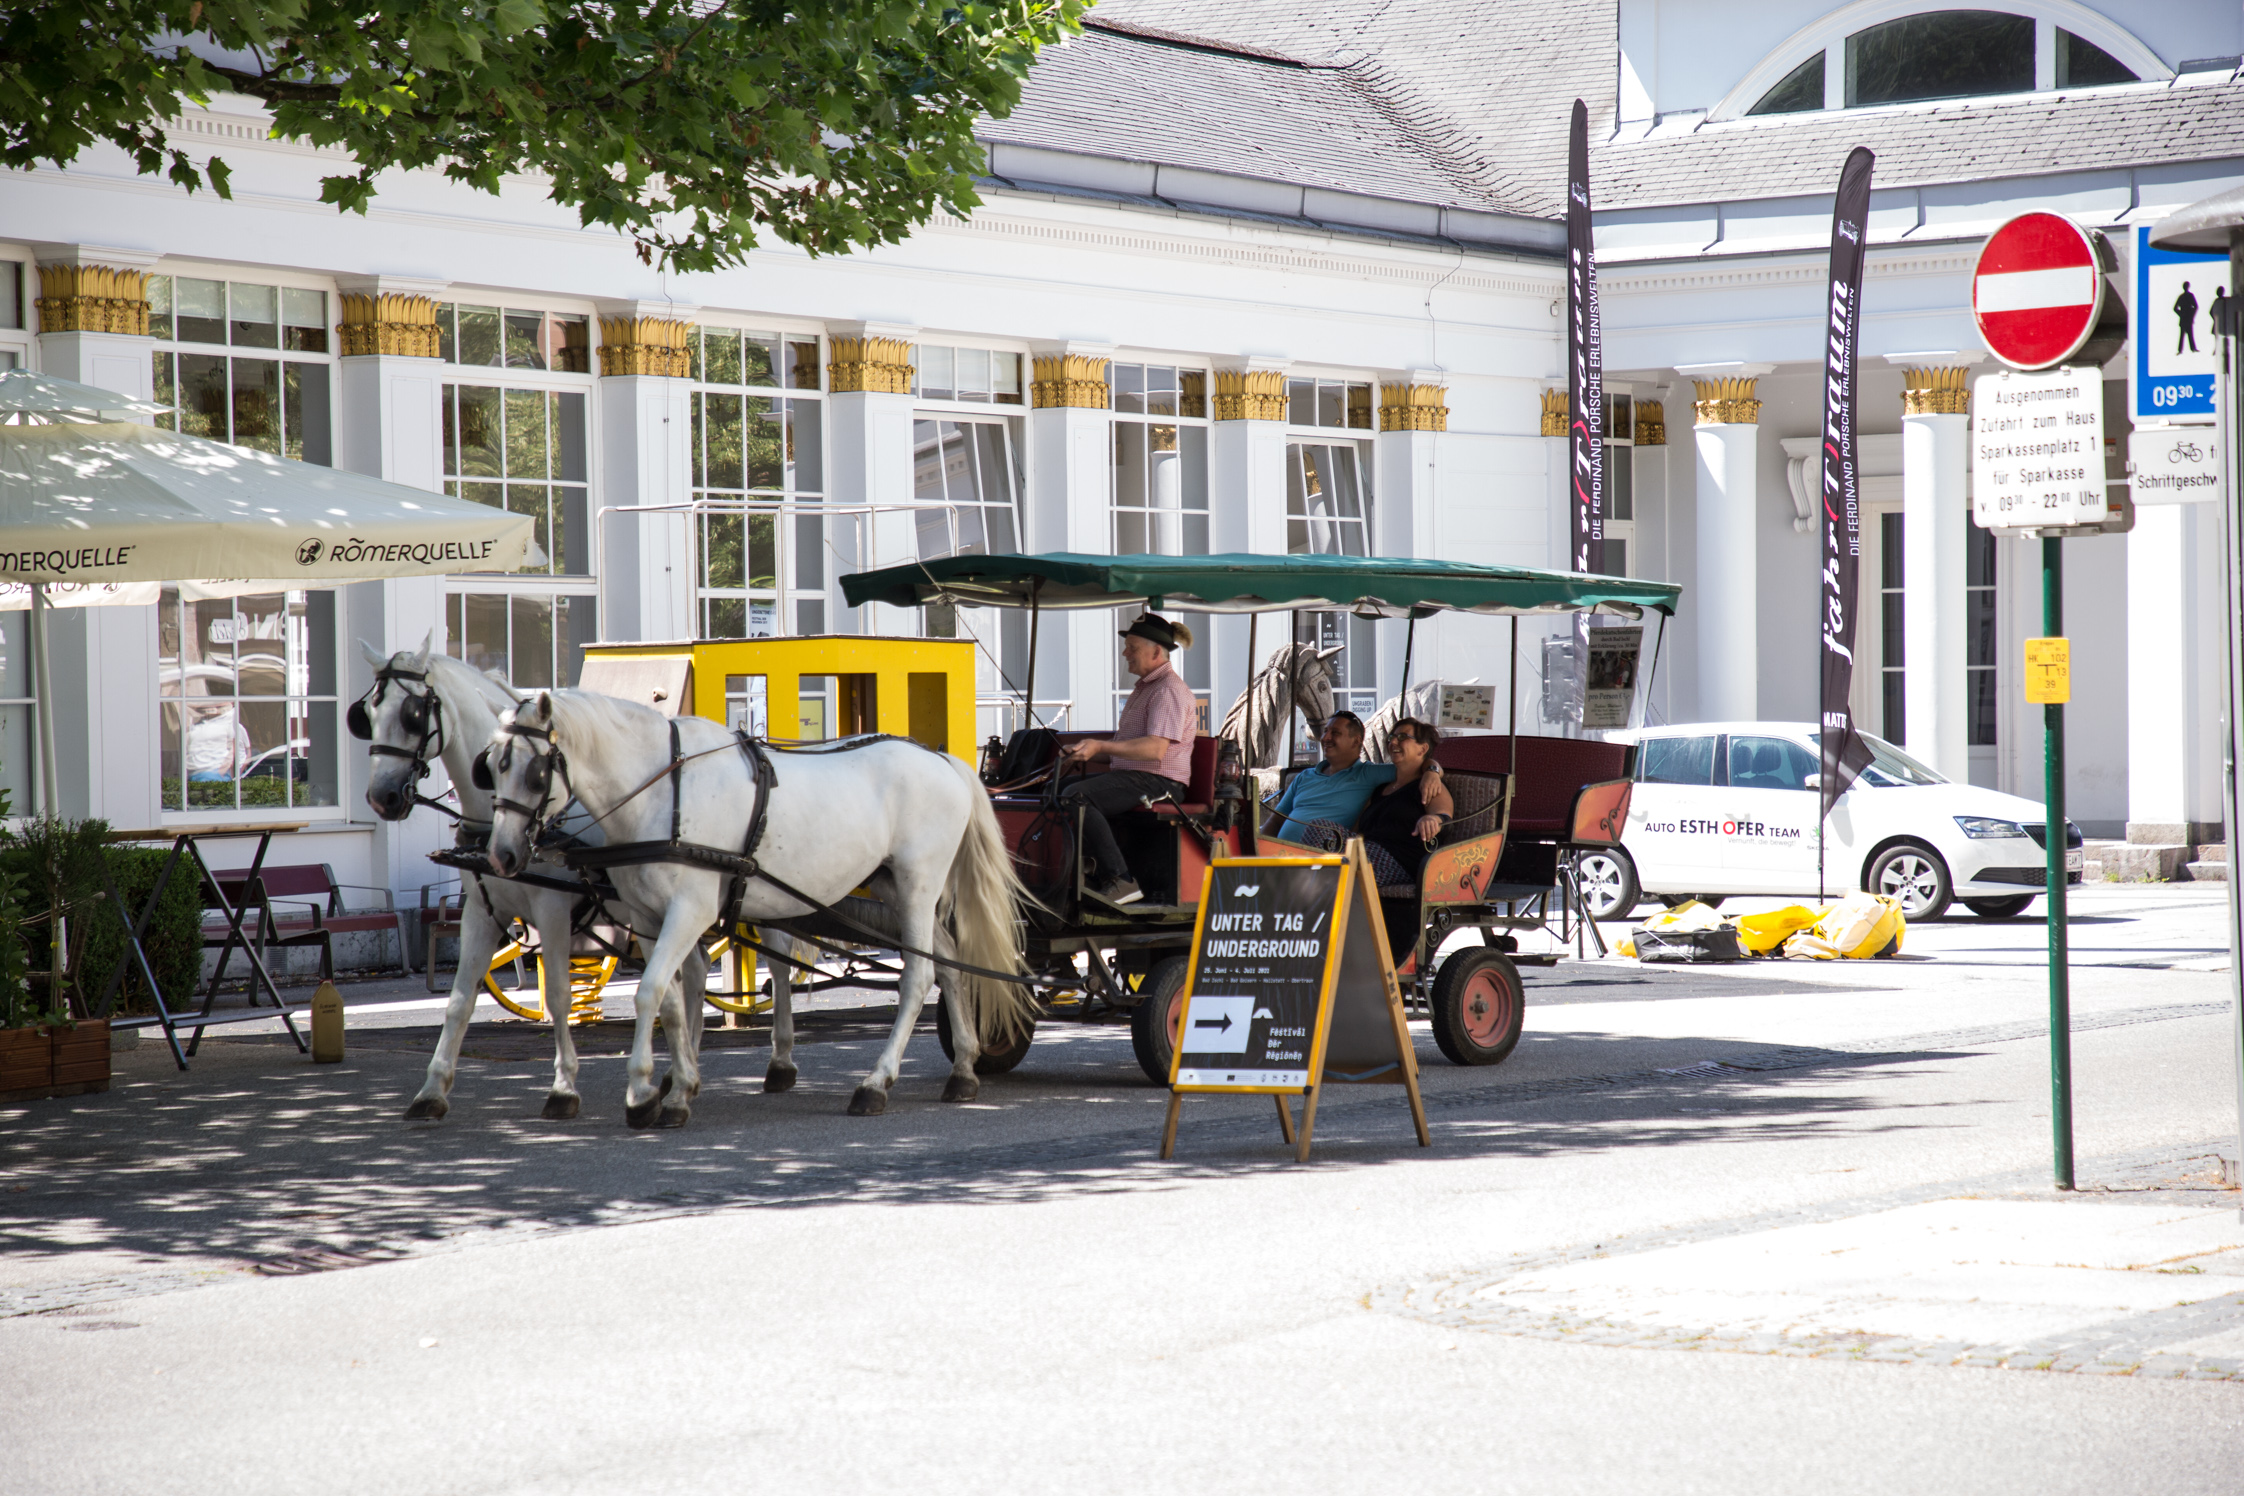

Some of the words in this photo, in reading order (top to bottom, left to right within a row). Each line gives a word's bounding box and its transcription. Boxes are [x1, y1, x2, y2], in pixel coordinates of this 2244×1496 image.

[1841, 288, 1854, 397] ERLEBNISWELTEN
[1590, 372, 1600, 432] PORSCHE
[1996, 386, 2080, 406] Ausgenommen
[1841, 400, 1850, 456] PORSCHE
[1981, 415, 2023, 433] Zufahrt
[2033, 416, 2058, 429] zum
[2066, 410, 2096, 426] Haus
[1981, 438, 2080, 462] Sparkassenplatz
[2090, 436, 2096, 451] 1
[1591, 437, 1601, 514] FERDINAND
[1993, 470, 2010, 485] für
[2019, 466, 2085, 487] Sparkasse
[2138, 471, 2217, 491] Schrittgeschw
[1844, 461, 1858, 531] FERDINAND
[1980, 502, 1991, 513] v.
[2079, 490, 2101, 506] Uhr
[1593, 519, 1601, 539] DIE
[1850, 536, 1859, 555] DIE
[2051, 653, 2067, 662] 102
[2045, 680, 2056, 689] 39
[1588, 694, 1599, 702] pro
[1599, 692, 1618, 700] Person
[1645, 822, 1676, 833] AUTO
[1769, 827, 1800, 838] TEAM
[1211, 913, 1263, 932] UNTER
[1274, 913, 1304, 932] TAG
[1206, 940, 1320, 958] UNDERGROUND
